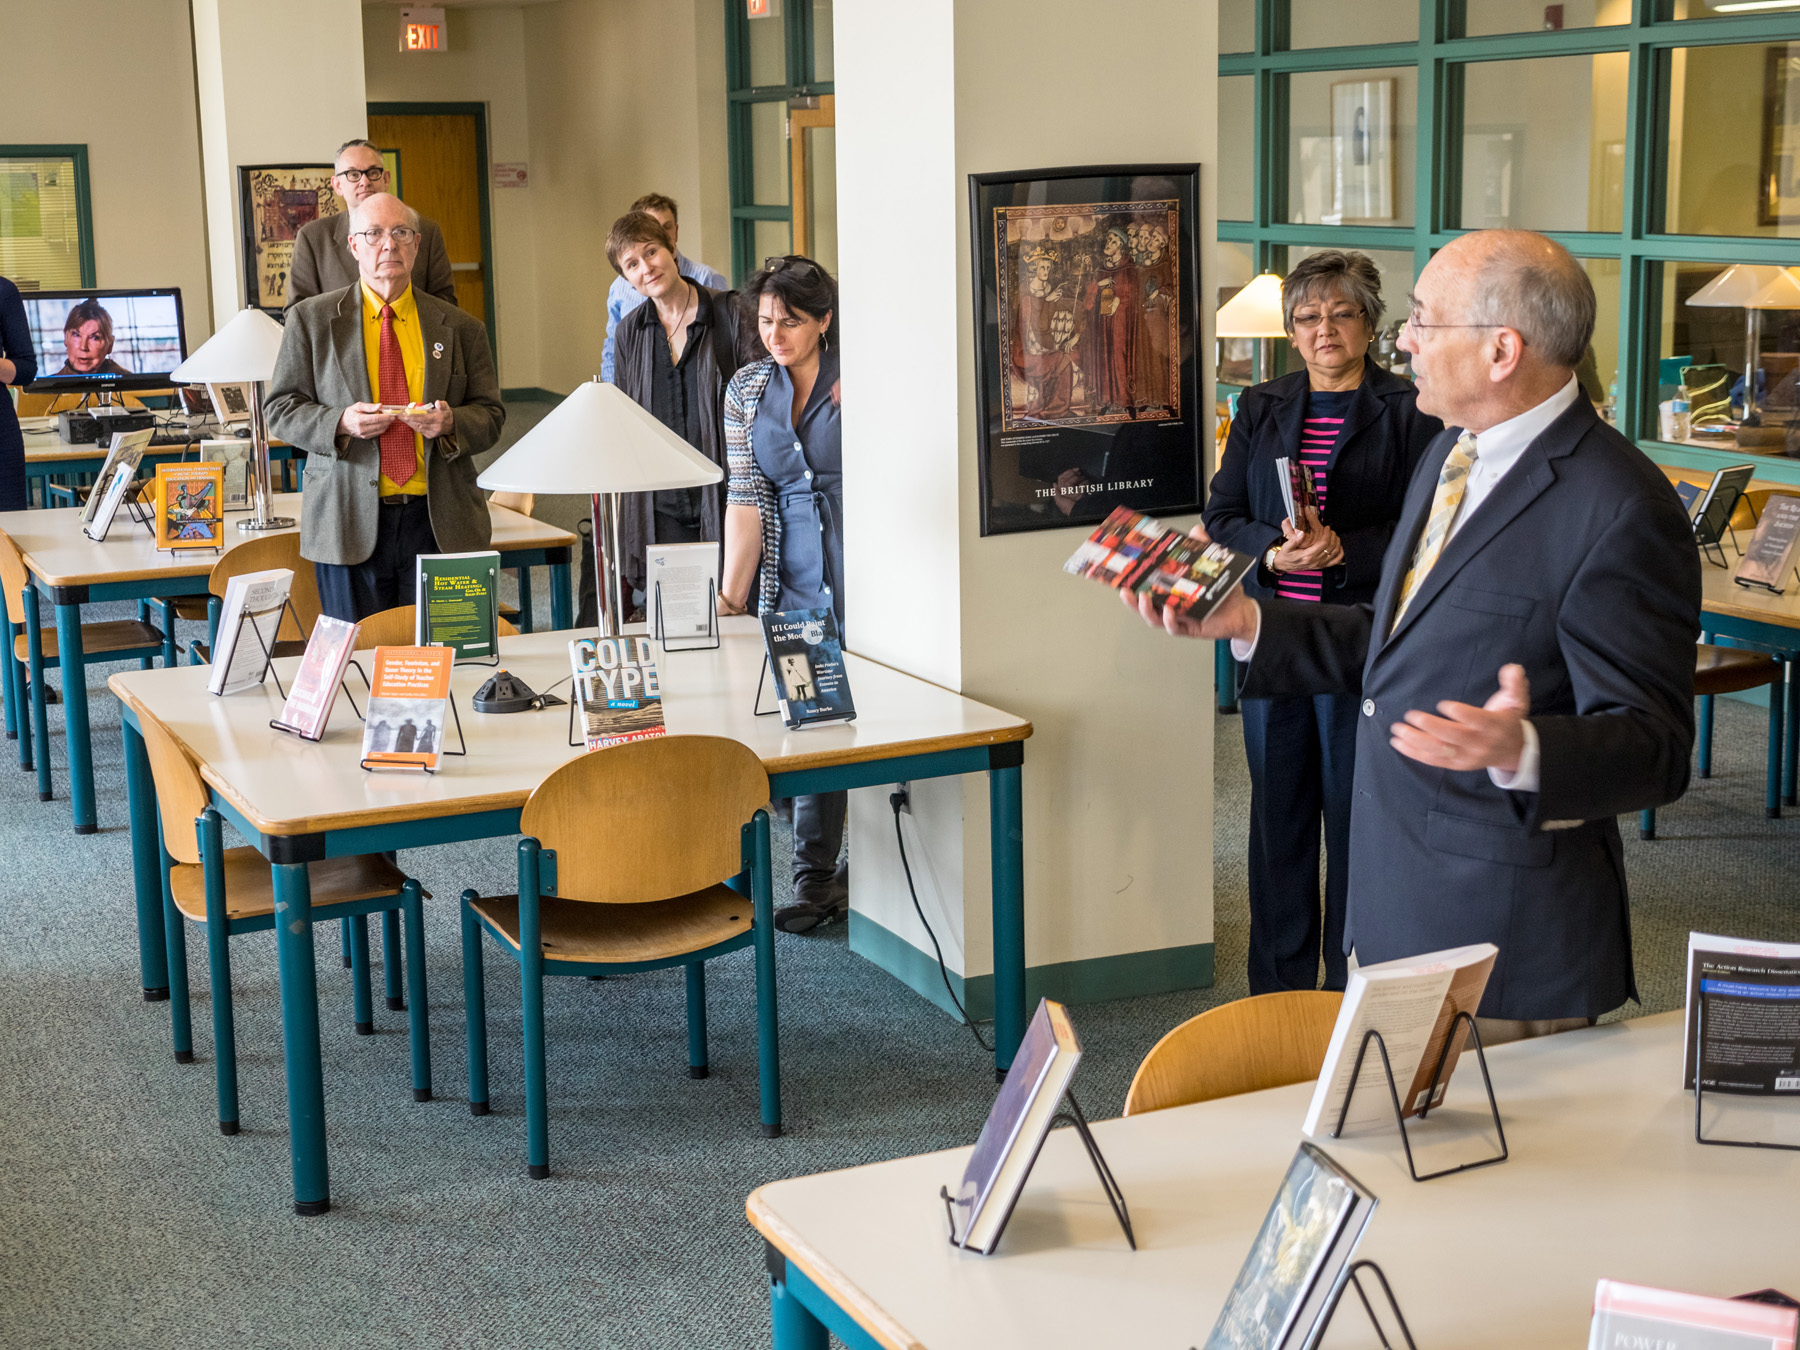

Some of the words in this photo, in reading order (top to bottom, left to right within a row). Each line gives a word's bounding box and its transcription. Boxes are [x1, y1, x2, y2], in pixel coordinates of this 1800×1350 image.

[407, 24, 439, 50] EXIT
[1035, 488, 1056, 498] THE
[1060, 483, 1104, 495] BRITISH
[1107, 478, 1154, 491] LIBRARY
[771, 624, 779, 633] If
[779, 624, 783, 632] I
[783, 621, 805, 631] Could
[773, 634, 787, 643] the
[574, 637, 656, 672] COLD
[385, 659, 404, 667] Gender,
[400, 667, 416, 675] Theory
[383, 674, 409, 682] Self-Study
[577, 666, 661, 702] TYPE
[588, 736, 628, 751] HARVEY
[1738, 966, 1765, 974] Research
[1614, 1331, 1677, 1350] POWER
